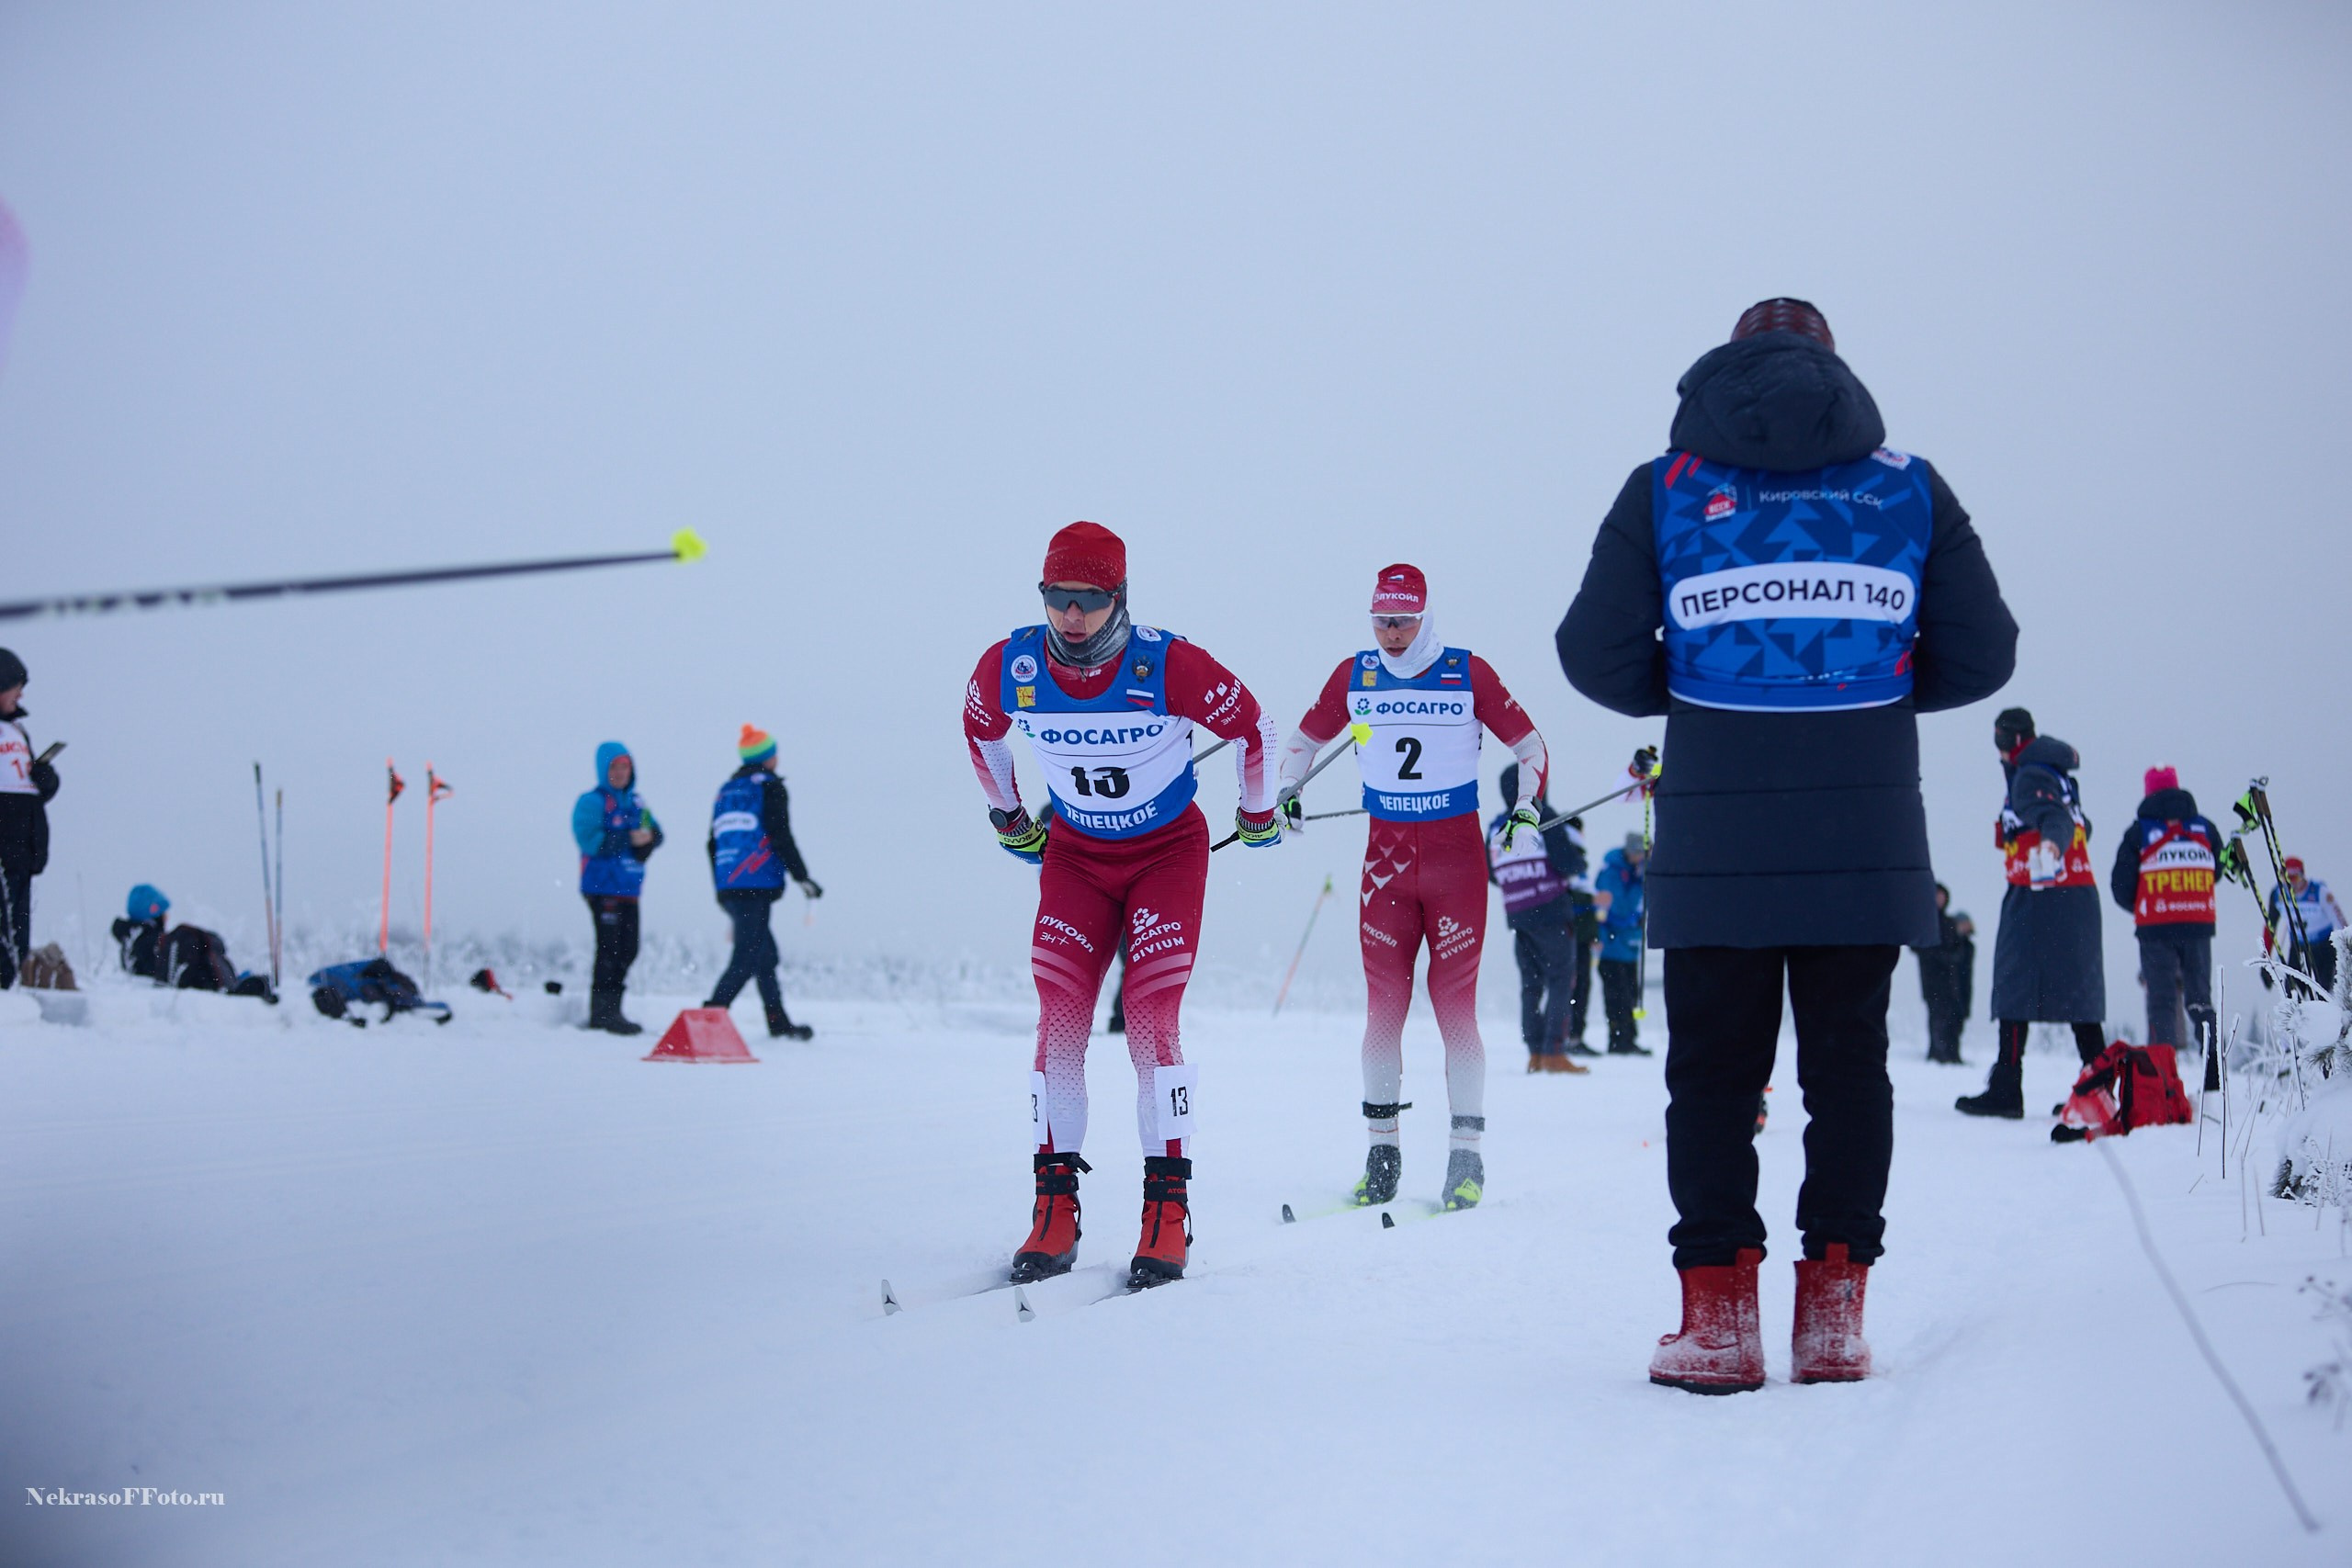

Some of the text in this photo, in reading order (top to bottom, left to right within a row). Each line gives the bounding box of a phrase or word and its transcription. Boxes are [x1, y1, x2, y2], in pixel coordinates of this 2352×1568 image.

[1758, 489, 1850, 504] Кировский
[1378, 592, 1419, 604] ЛУКОЙЛ
[1681, 579, 1905, 617] ПЕРСОНАЛ 140
[966, 692, 992, 721] САГРО
[1204, 678, 1241, 724] ЛУКОЙЛ
[1376, 701, 1464, 716] ФОСАГРО
[1040, 724, 1163, 746] ФОСАГРО
[1395, 737, 1423, 781] 2
[1070, 766, 1131, 799] 13
[1060, 799, 1159, 831] ЧЕПЕЦКОЕ
[1379, 793, 1450, 814] ЧЕПЕЦКОЕ
[2143, 869, 2214, 896] ТРЕНЕР
[1039, 915, 1094, 953] ЛУКОЙЛ
[1129, 921, 1182, 953] ФОСАГРО
[1362, 921, 1397, 948] ЛУКОЙЛ
[1435, 927, 1474, 951] ФОСАГРО
[1131, 936, 1185, 963] BIVIUM
[1440, 937, 1476, 961] BIVIUM
[1031, 1093, 1039, 1123] 3
[1170, 1086, 1189, 1118] 13
